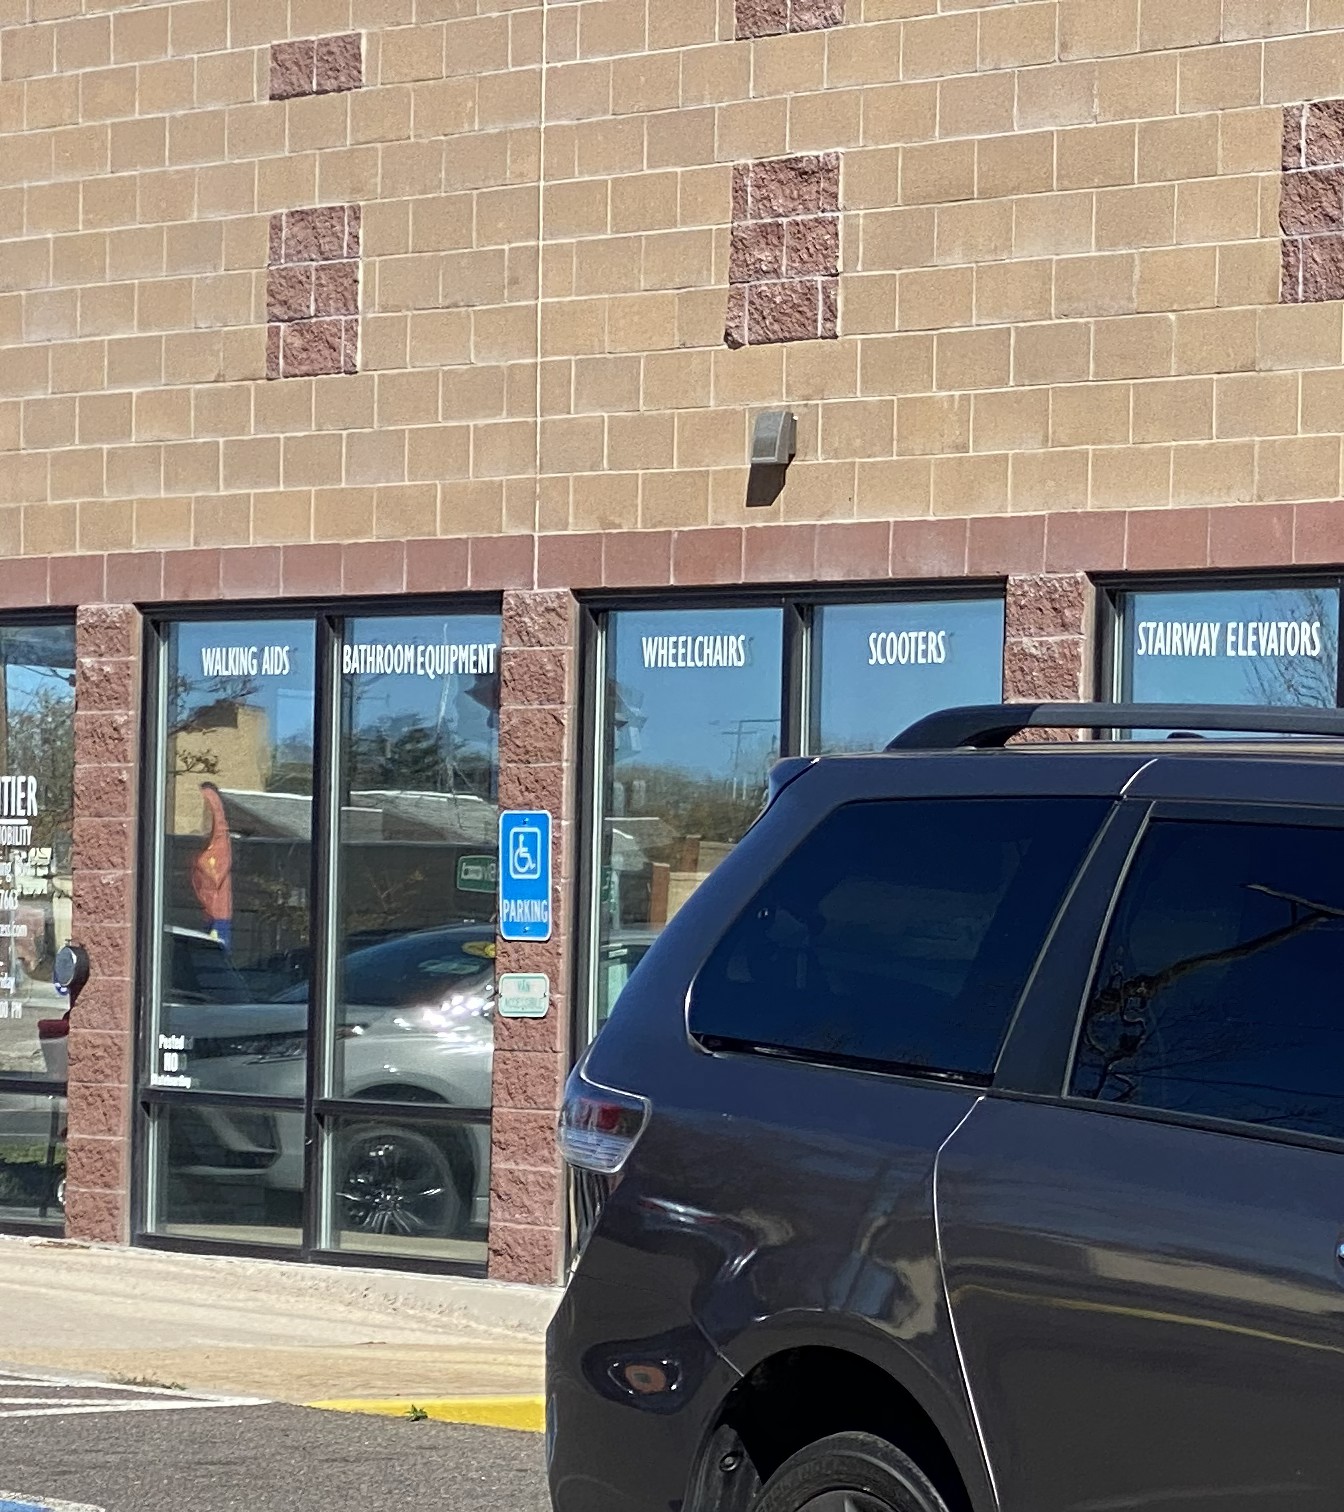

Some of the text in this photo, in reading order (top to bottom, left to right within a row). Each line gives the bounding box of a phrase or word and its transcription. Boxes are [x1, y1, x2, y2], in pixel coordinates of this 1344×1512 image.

[641, 634, 746, 668] WHEELCHAIRS
[868, 630, 946, 665] SCOOTERS
[1137, 621, 1321, 657] STAIRWAY ELEVATORS
[201, 646, 290, 676] WALKING AIDS
[342, 643, 497, 680] BATHROOM EQUIPMENT
[0, 825, 33, 846] OBILITY
[502, 900, 548, 923] PARKING
